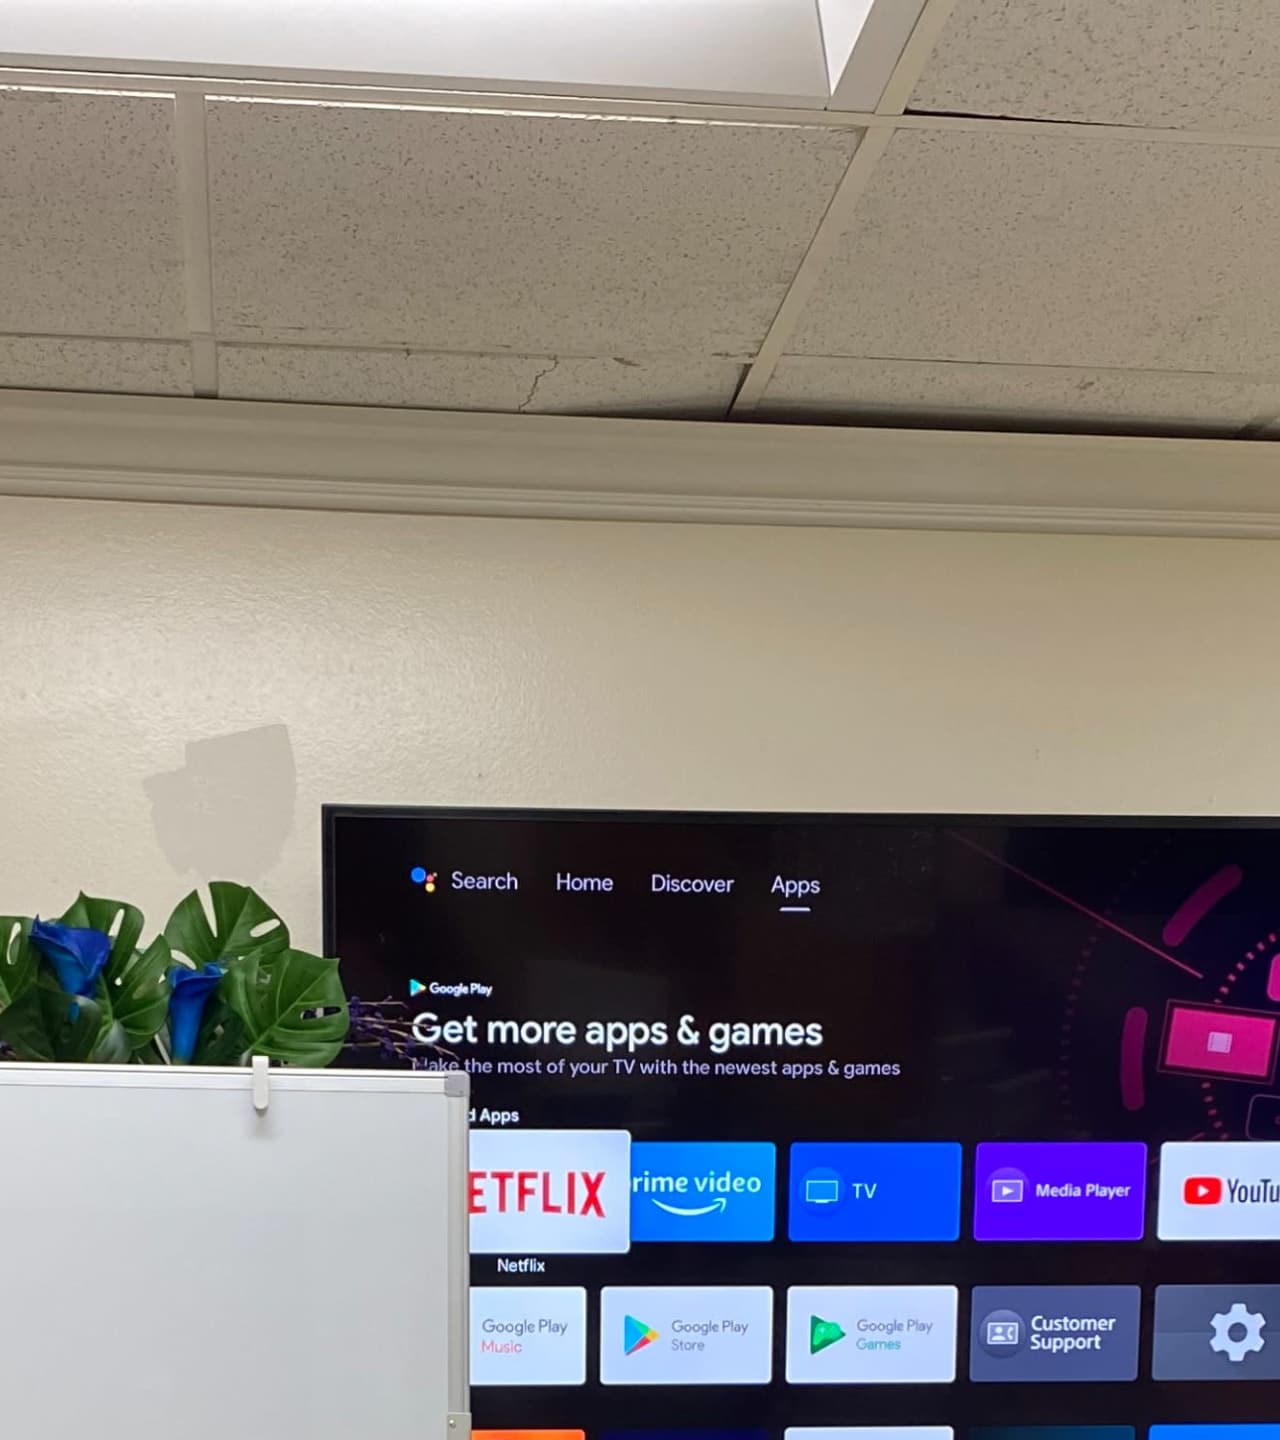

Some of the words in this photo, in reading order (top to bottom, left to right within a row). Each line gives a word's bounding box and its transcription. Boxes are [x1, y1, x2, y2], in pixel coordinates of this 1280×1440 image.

[452, 871, 518, 889] Search
[557, 873, 613, 891] Home
[652, 874, 734, 892] Discover
[771, 876, 820, 898] Apps
[429, 982, 468, 997] Google
[470, 983, 492, 997] Play
[411, 1012, 478, 1046] Get
[488, 1021, 576, 1044] more
[585, 1022, 668, 1052] apps
[677, 1015, 699, 1045] &
[709, 1023, 823, 1053] games
[464, 1058, 492, 1073] the
[498, 1060, 541, 1073] most
[547, 1059, 565, 1073] of
[570, 1063, 608, 1077] your
[613, 1059, 635, 1074] TV
[640, 1059, 677, 1074] with
[682, 1060, 710, 1074] the
[715, 1061, 777, 1075] newest
[782, 1064, 823, 1079] apps
[828, 1060, 839, 1075] &
[844, 1064, 900, 1079] games
[480, 1108, 519, 1125] Apps
[631, 1171, 688, 1192] rime
[694, 1171, 761, 1192] video
[468, 1171, 605, 1217] ETFLIX
[852, 1183, 877, 1198] TV
[1036, 1184, 1081, 1197] Media
[1086, 1184, 1131, 1200] Player
[498, 1258, 545, 1272] Netflix
[482, 1319, 535, 1336] Google
[539, 1319, 568, 1336] Play
[672, 1320, 719, 1336] Google
[722, 1320, 748, 1335] Play
[857, 1319, 904, 1335] Google
[907, 1319, 933, 1334] Play
[1032, 1316, 1116, 1332] Customer
[482, 1337, 522, 1353] Music
[672, 1339, 705, 1351] Store
[856, 1338, 901, 1350] Games
[1031, 1334, 1101, 1353] Support
